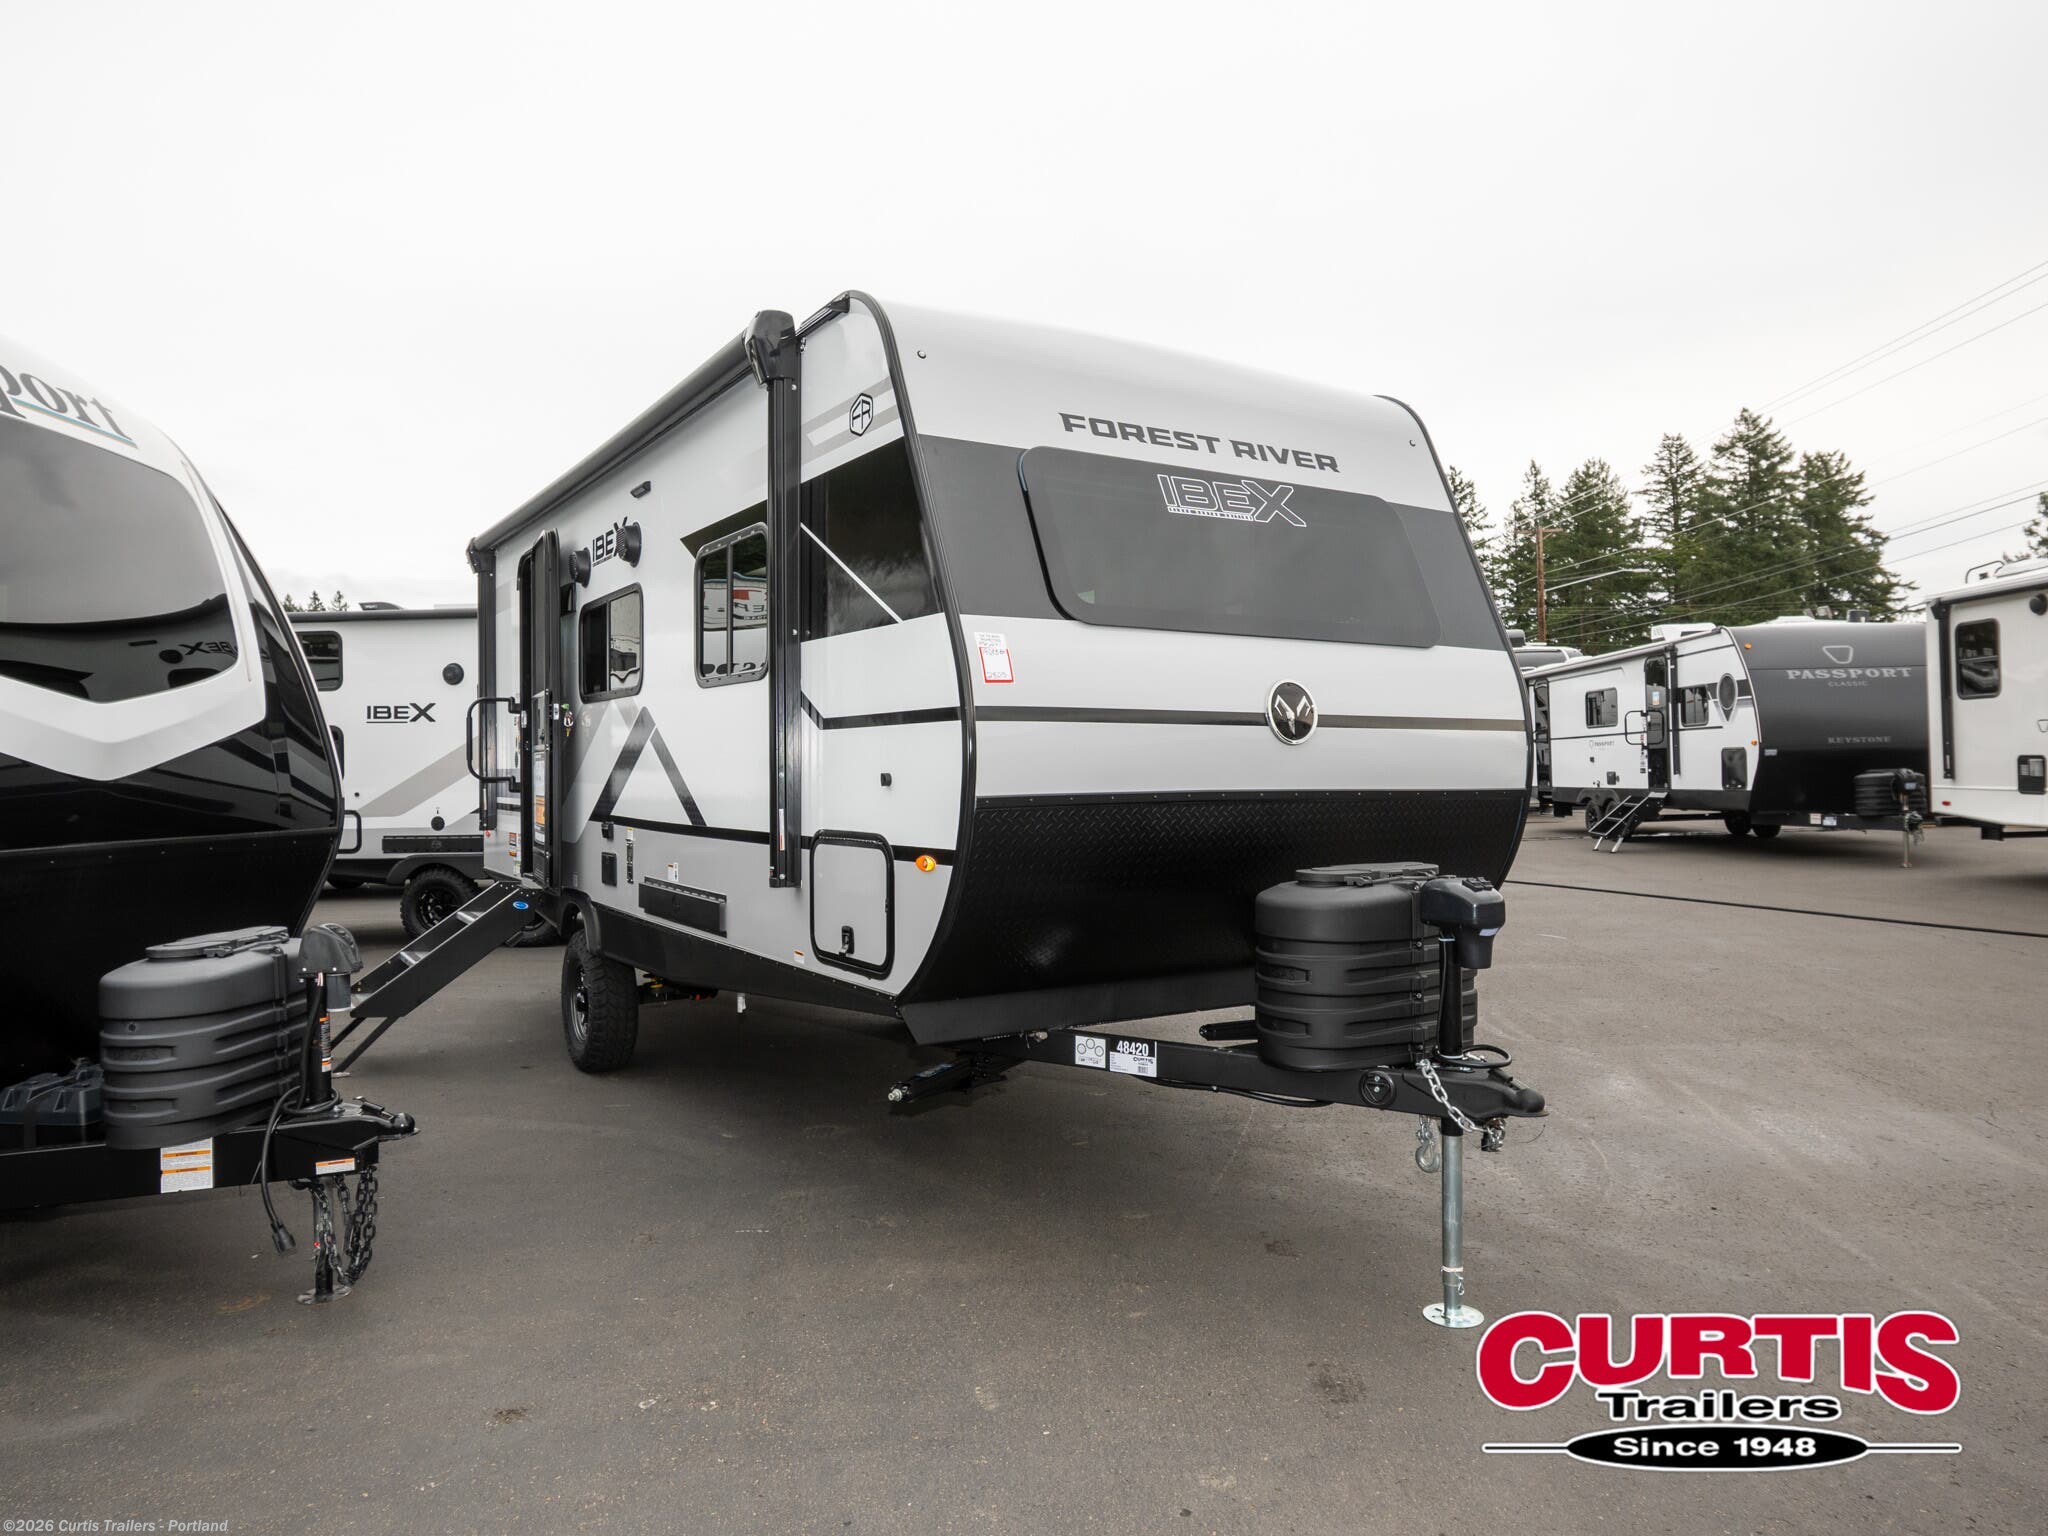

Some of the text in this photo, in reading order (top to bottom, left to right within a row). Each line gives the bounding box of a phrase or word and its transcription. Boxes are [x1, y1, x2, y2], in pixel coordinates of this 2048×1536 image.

[1058, 412, 1341, 473] FOREST RIVER
[1157, 474, 1307, 527] IBEX
[1786, 668, 1911, 679] PASSPORT
[367, 703, 436, 723] IBEX
[1828, 736, 1891, 744] KEYSTONE
[1116, 1040, 1149, 1057] 48420
